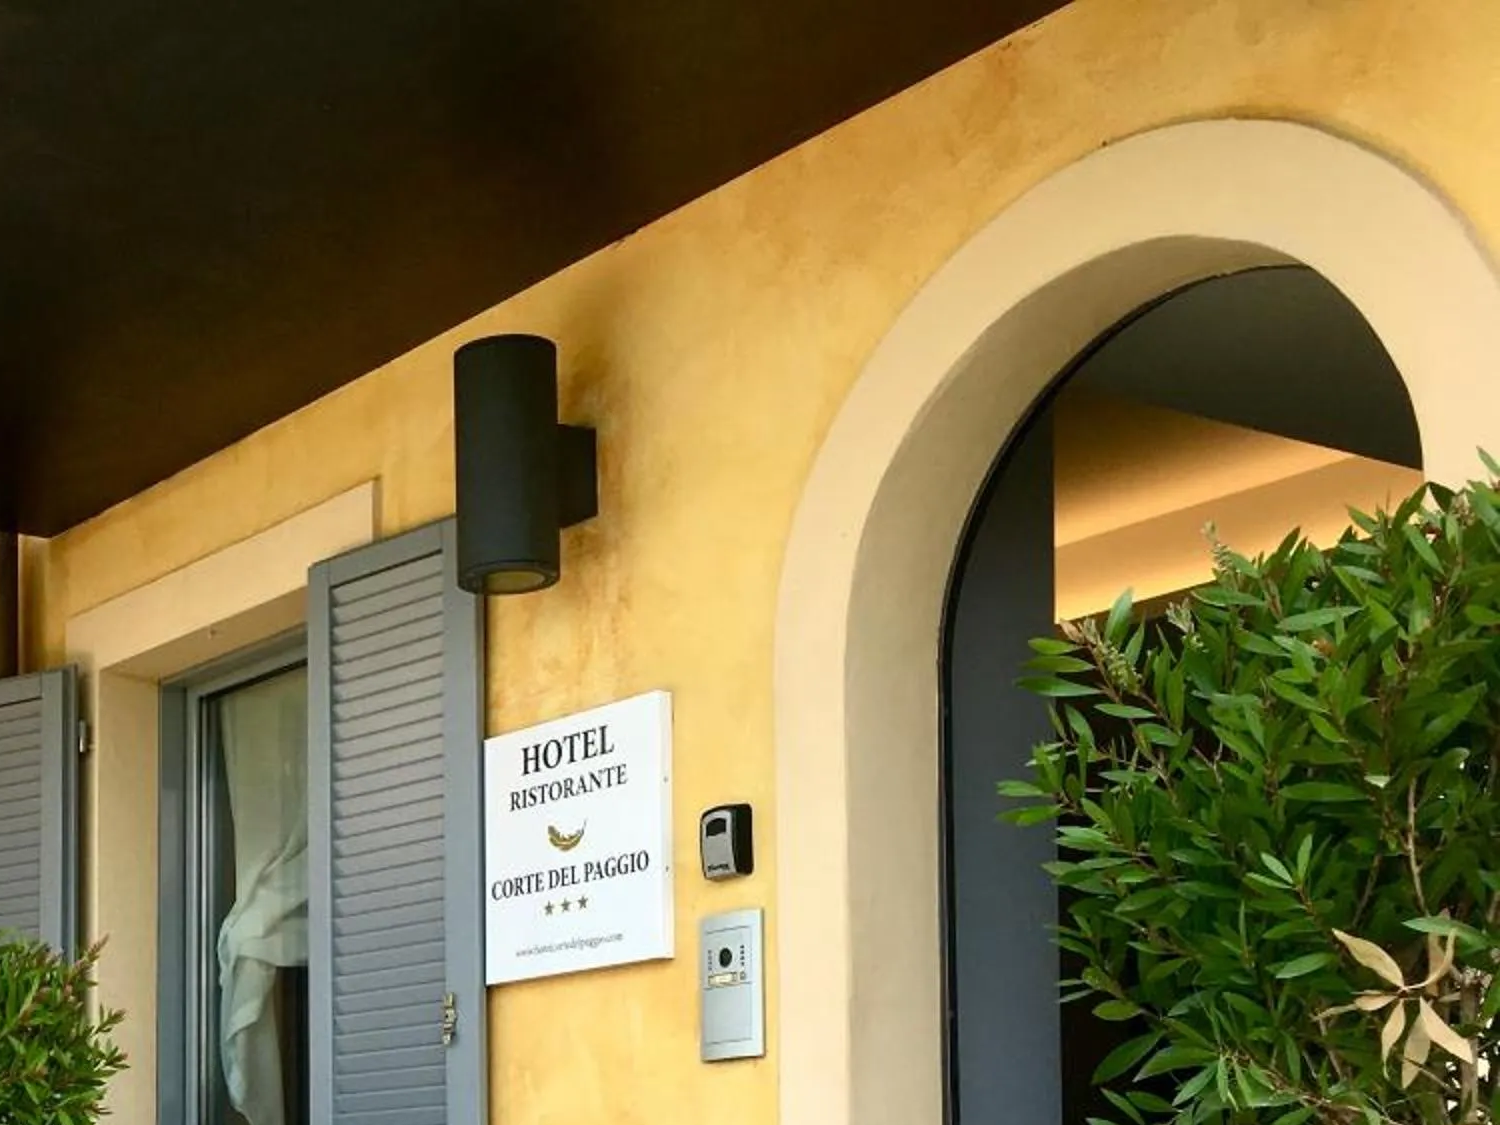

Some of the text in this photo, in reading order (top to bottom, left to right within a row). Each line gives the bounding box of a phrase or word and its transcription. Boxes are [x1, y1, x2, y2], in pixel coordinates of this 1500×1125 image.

[521, 725, 615, 776] HOTEL
[509, 763, 628, 812] RISTORANTE
[491, 850, 650, 902] CORTE DEL PAGGIO
